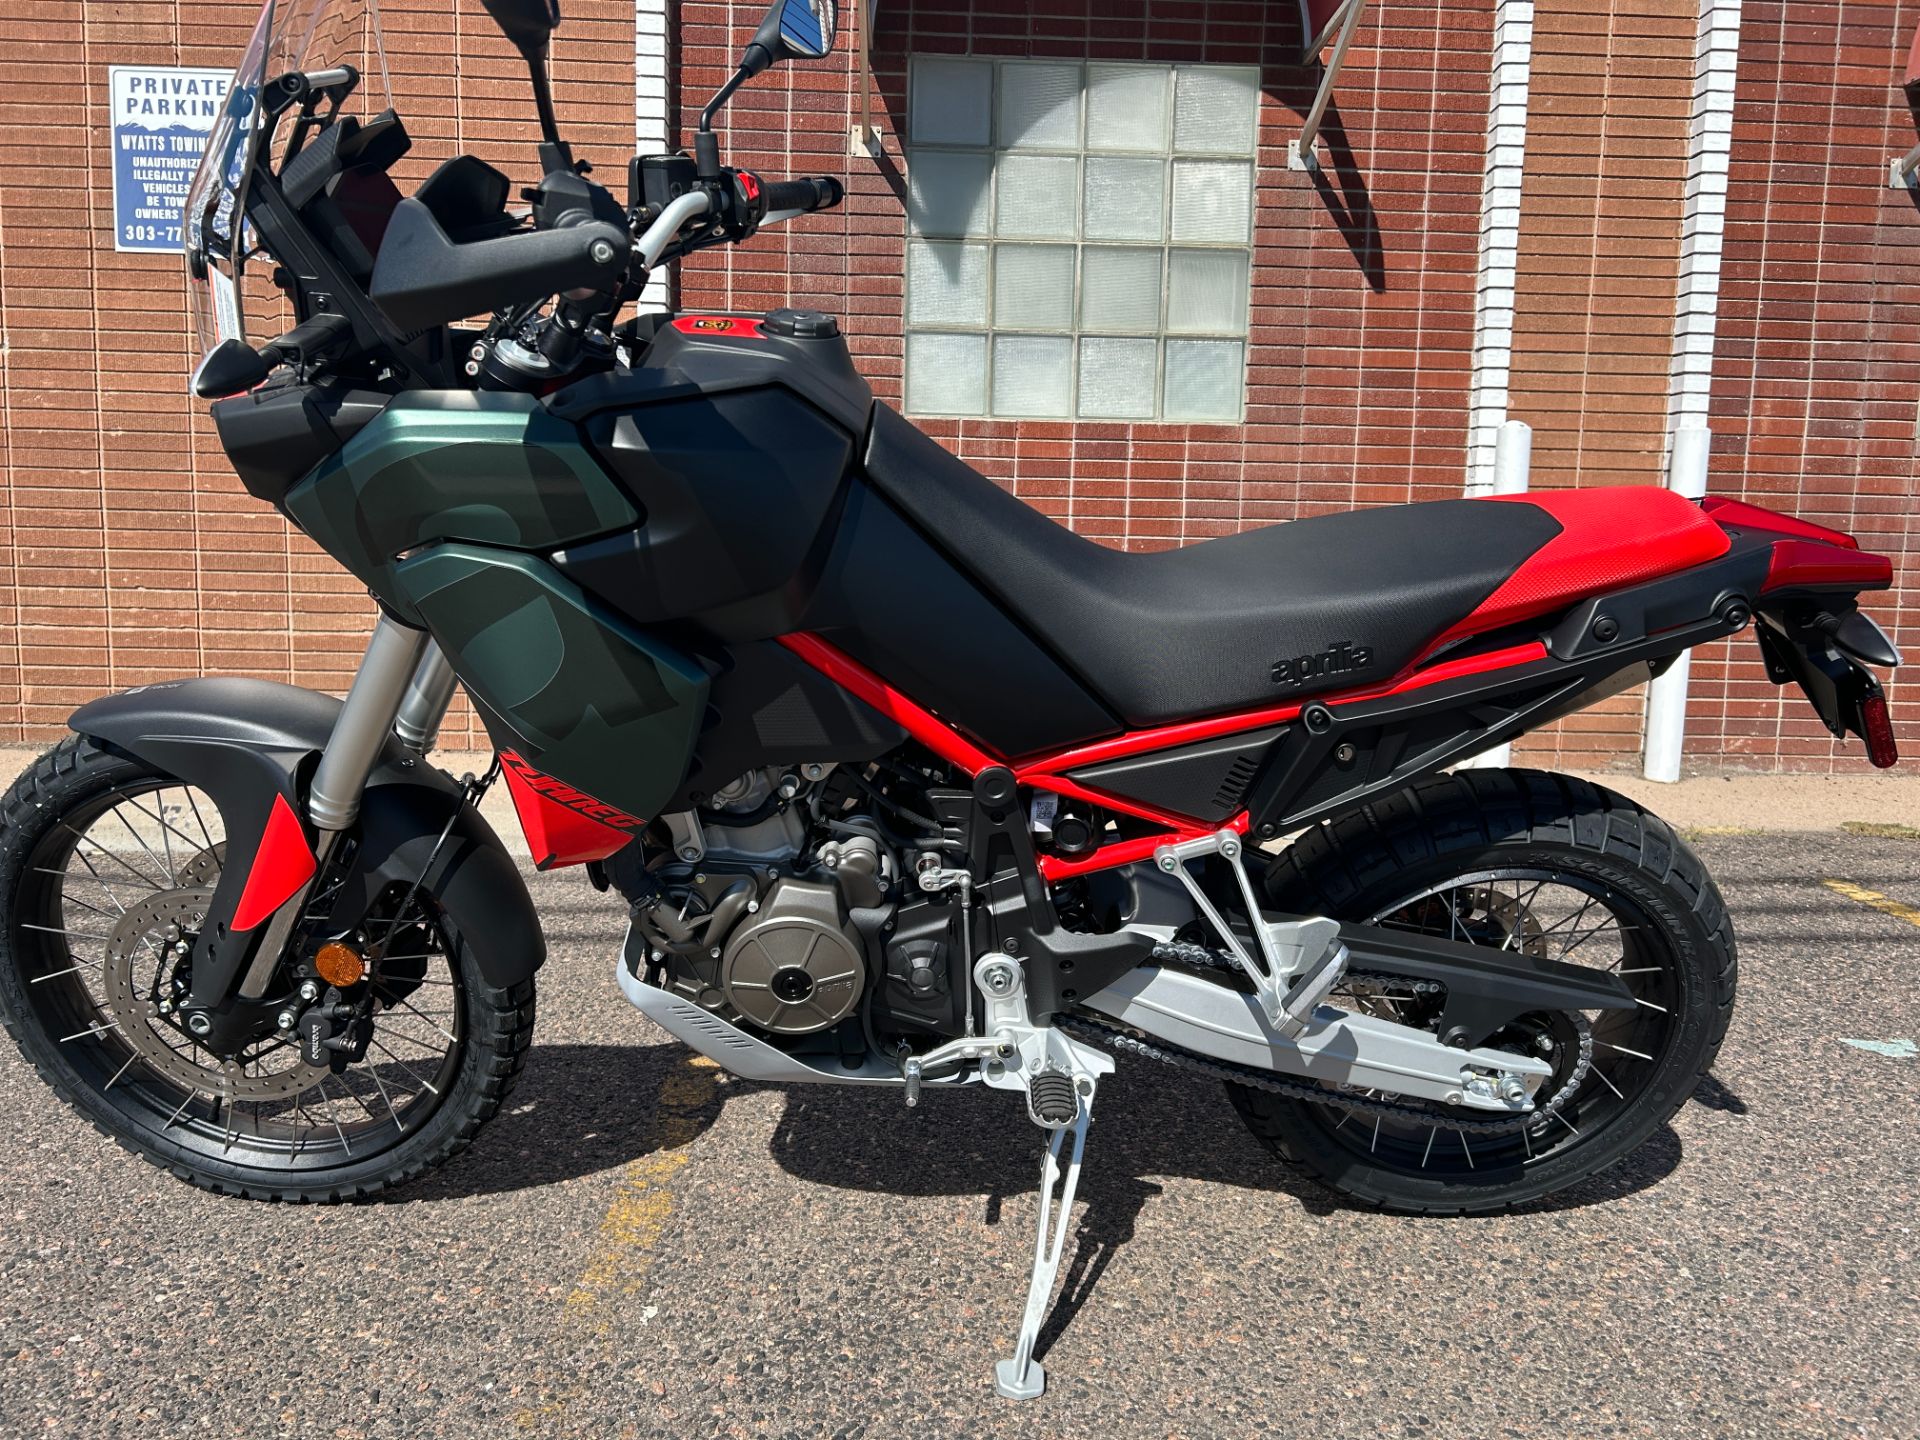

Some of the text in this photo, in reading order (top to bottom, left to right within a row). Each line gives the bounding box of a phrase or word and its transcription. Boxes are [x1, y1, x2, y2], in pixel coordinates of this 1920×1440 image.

[130, 77, 226, 96] PRIVATE
[121, 134, 209, 152] WYATTS TOWIN
[133, 170, 184, 181] ILLEGALLY
[143, 183, 190, 195] VEHICLES
[147, 196, 188, 207] BE TOW
[135, 208, 179, 220] OWNERS
[125, 225, 182, 242] 303-77
[1271, 641, 1374, 687] aprilia
[312, 1024, 322, 1060] brembo
